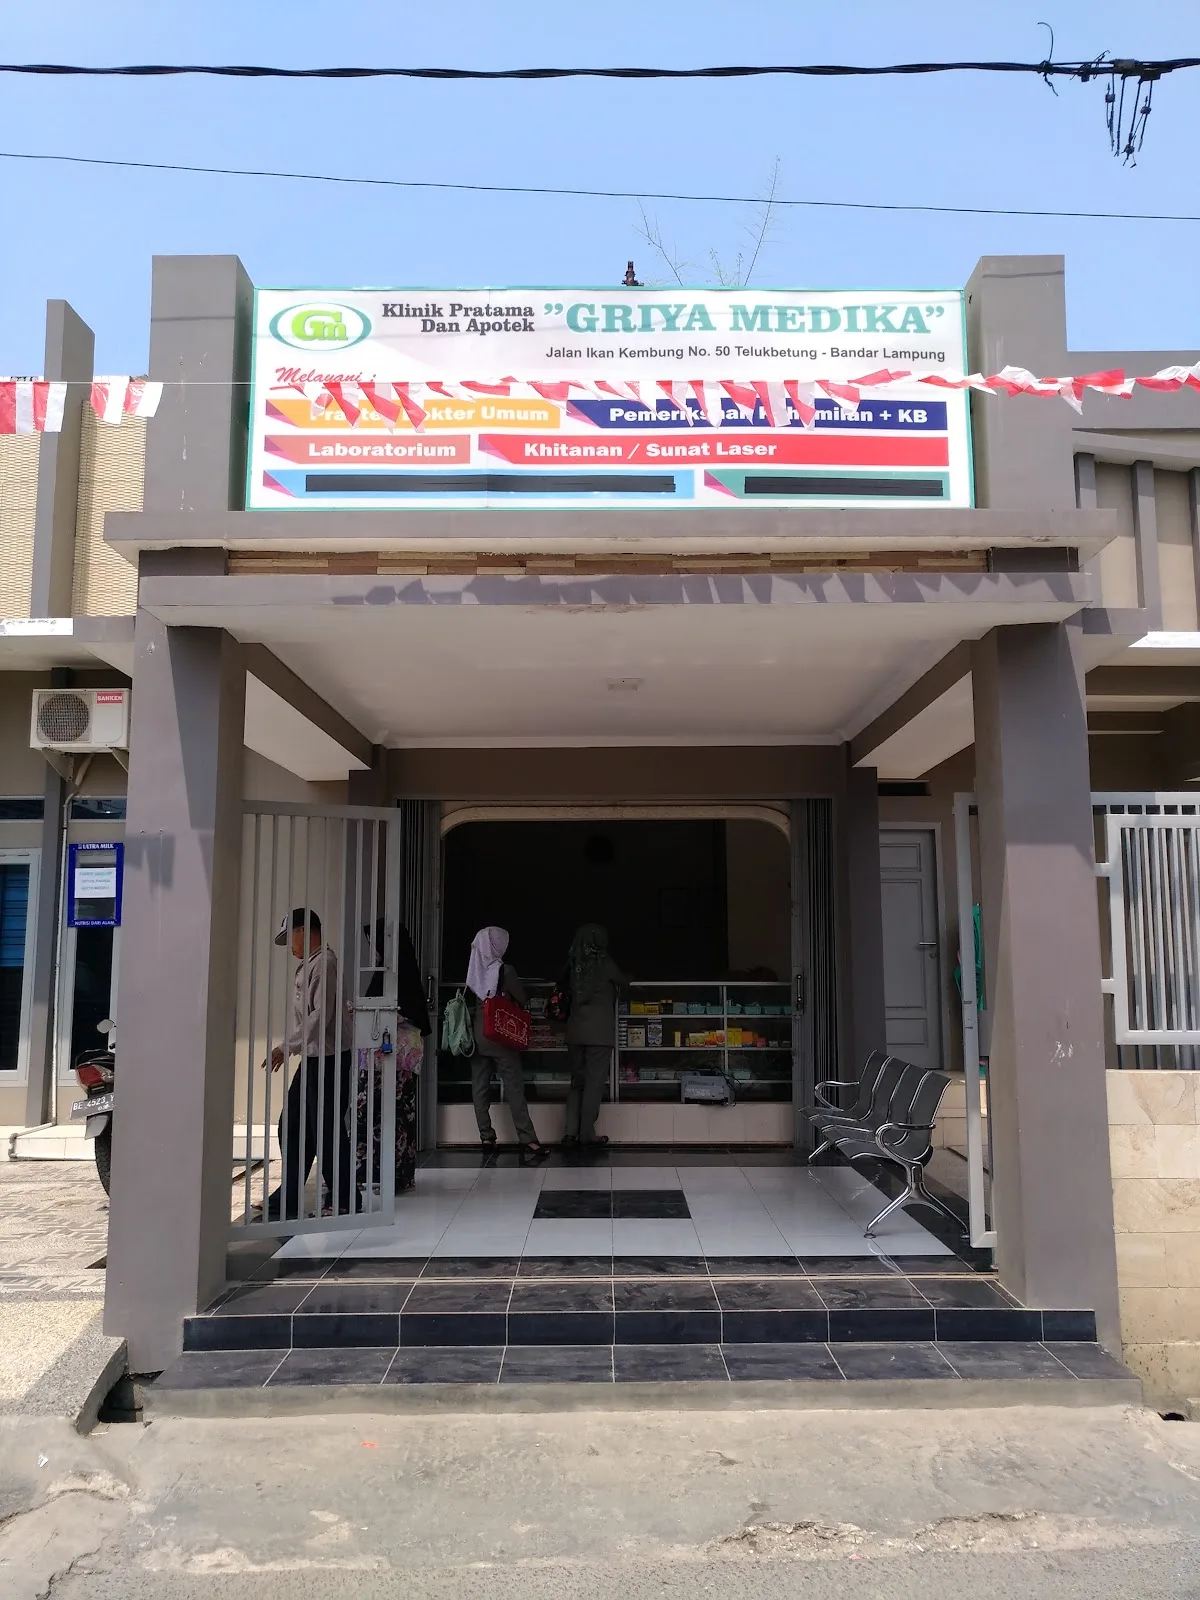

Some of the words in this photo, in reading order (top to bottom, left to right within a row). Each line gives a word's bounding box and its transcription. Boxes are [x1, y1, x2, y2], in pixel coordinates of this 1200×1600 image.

[382, 303, 444, 317] Klinik
[449, 303, 535, 317] Pratama
[421, 319, 460, 333] Dan
[465, 318, 535, 335] Apotek
[546, 347, 582, 358] Jalan
[587, 347, 614, 358] Ikan
[619, 347, 684, 360] Kembung
[689, 346, 710, 357] No.
[715, 346, 731, 357] 50
[735, 346, 817, 360] Telukbetung
[830, 347, 878, 358] Bandar
[883, 347, 945, 363] Lampung
[310, 406, 395, 421] rate
[481, 405, 549, 421] Umum
[609, 406, 752, 422] Pemeriksan
[759, 405, 873, 422] hmilan
[879, 409, 892, 421] +
[898, 409, 928, 423] KB
[308, 442, 456, 457] Laboratorium
[524, 442, 623, 457] Khitanan
[627, 443, 640, 459] /
[646, 441, 710, 457] Sunat
[716, 441, 777, 456] Laser
